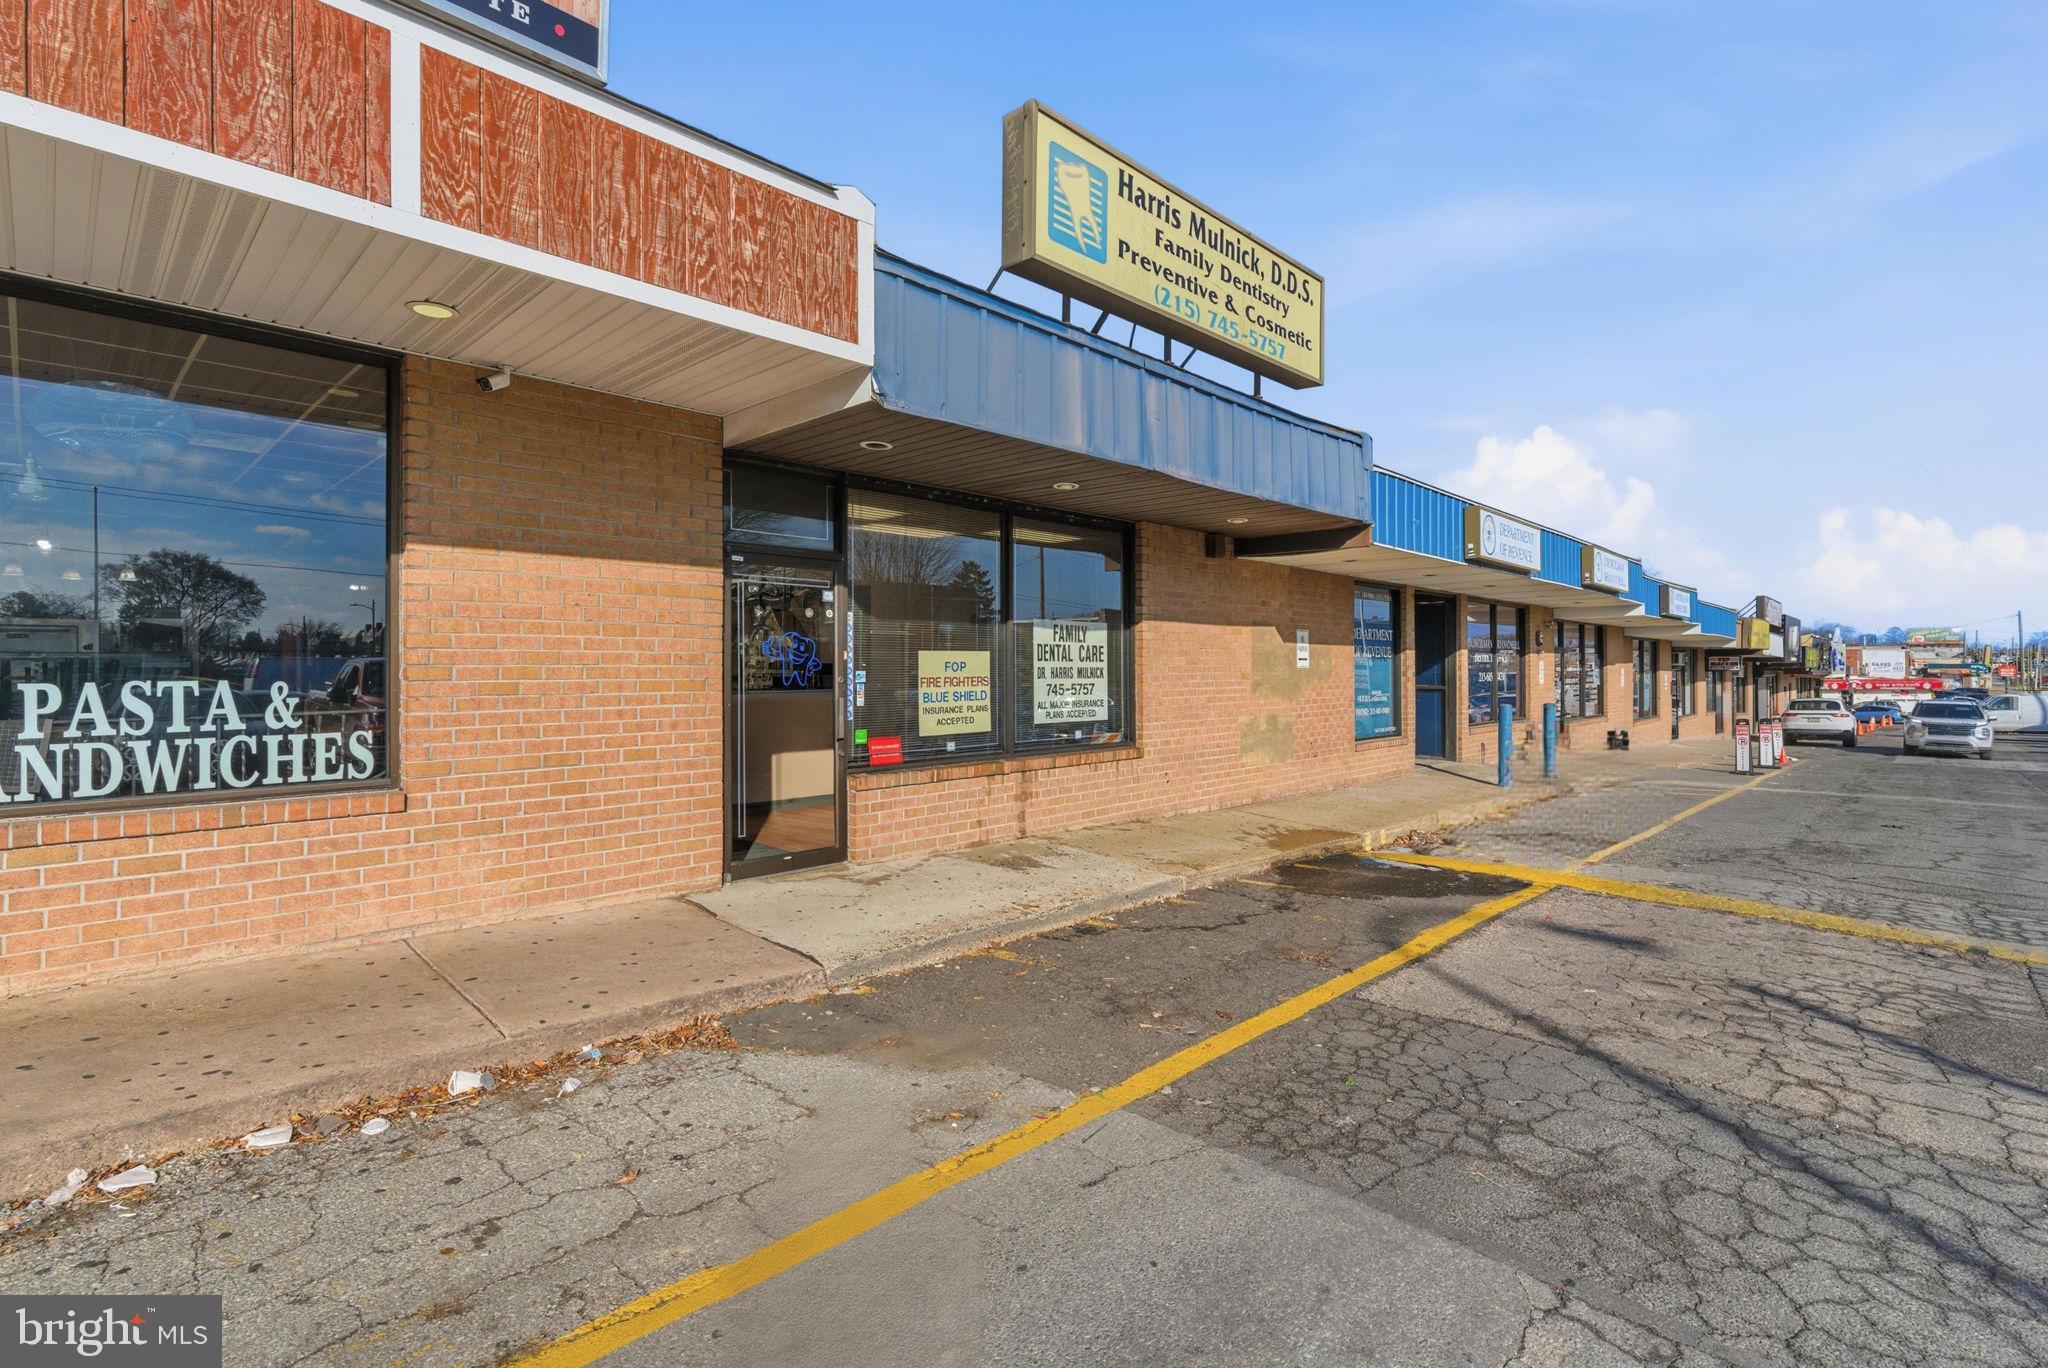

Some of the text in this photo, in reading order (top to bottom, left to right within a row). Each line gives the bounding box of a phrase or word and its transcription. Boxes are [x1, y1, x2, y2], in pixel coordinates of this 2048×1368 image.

[1117, 167, 1314, 306] Harris Mulnick, D.D.S.
[1155, 227, 1290, 318] Family Dentistry
[1117, 238, 1312, 351] Preventive & Cosmetic
[1154, 284, 1287, 360] (215) 745-5757
[1053, 624, 1088, 643] FAMILY
[1037, 643, 1105, 662] DENTAL CARE
[944, 662, 967, 673] FOP
[1037, 667, 1104, 679] DR. HARRIS MULNICK
[920, 675, 989, 688] FIRE FIGHTERS
[1046, 683, 1095, 696] 745-5757
[923, 690, 988, 703] BLUE SHIELD
[16, 679, 303, 741] PASTA &
[922, 704, 989, 715] INSURANCE PLANS
[1037, 701, 1048, 709] ALL
[1071, 699, 1105, 708] INSURANCE
[936, 716, 975, 726] ACCEPTED
[1046, 709, 1097, 720] PLANS ACCEPTED
[0, 730, 375, 804] NDWICHES
